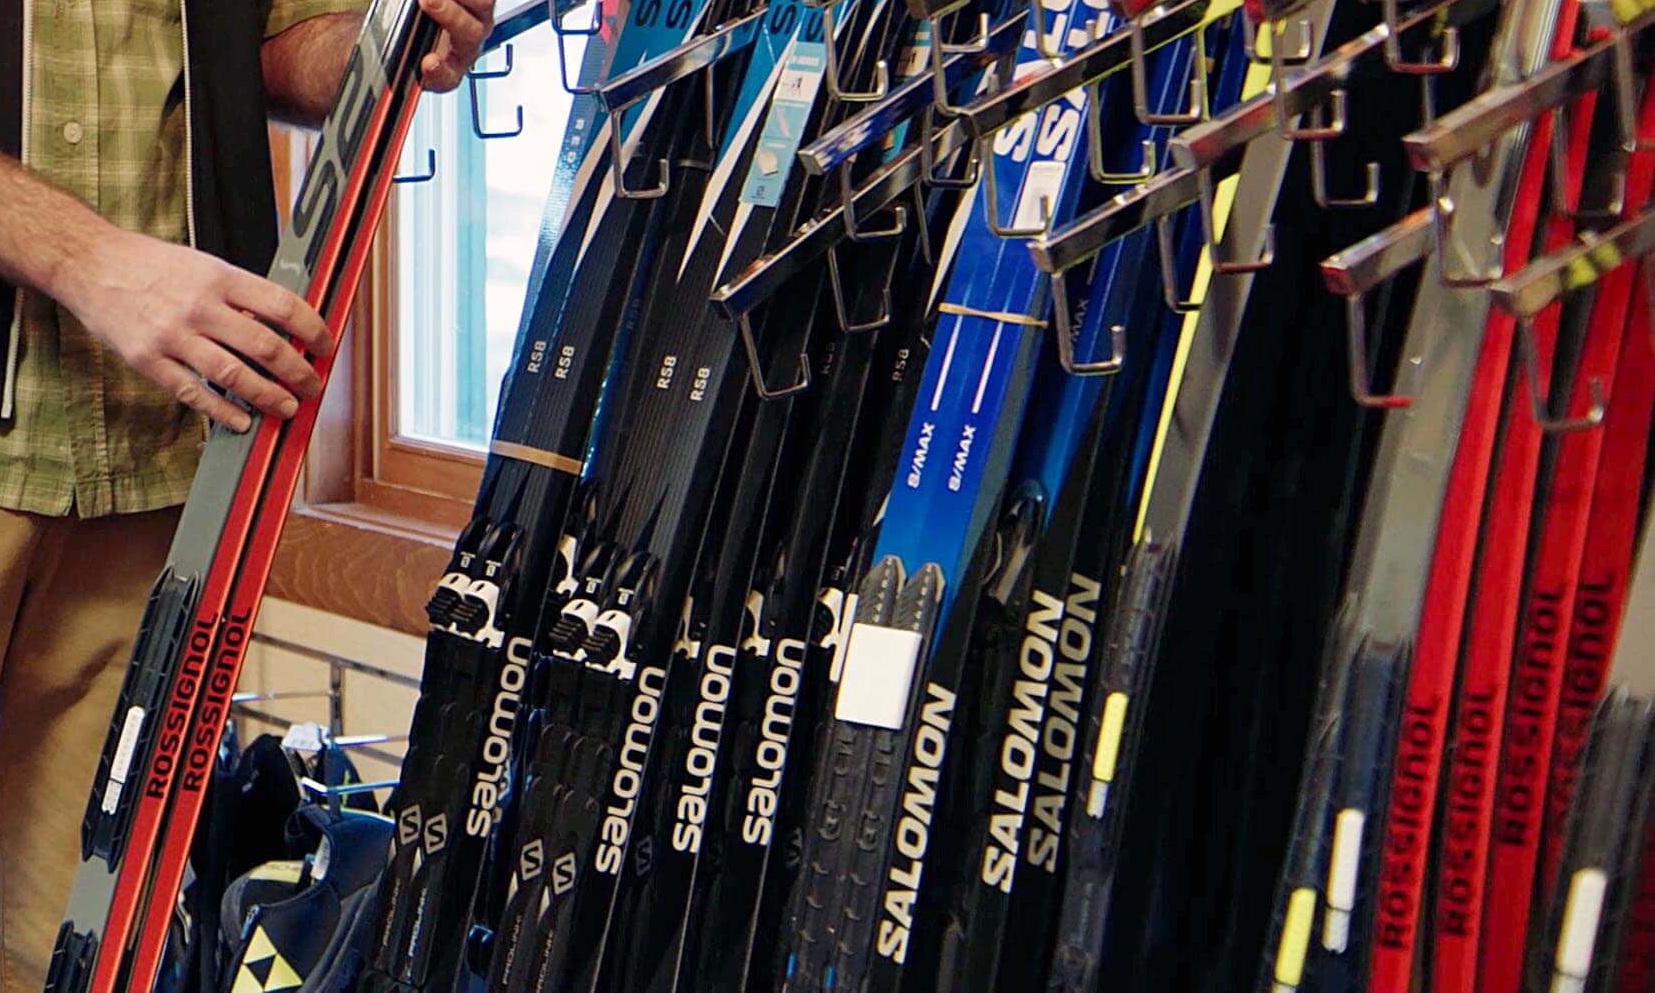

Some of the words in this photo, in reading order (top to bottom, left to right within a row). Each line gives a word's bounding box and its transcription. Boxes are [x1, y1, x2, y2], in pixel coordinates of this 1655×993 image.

[146, 613, 218, 799] ROSSIGNOL
[183, 607, 252, 793] ROSSIGNOL
[878, 682, 956, 965] SALOMON
[982, 590, 1065, 894] SALOMON
[1027, 574, 1103, 874] SALOMON
[1382, 693, 1439, 950] ROSSIGNOL
[1445, 683, 1496, 937] ROSSIGNOL
[1501, 582, 1566, 847] ROSSIGNOL
